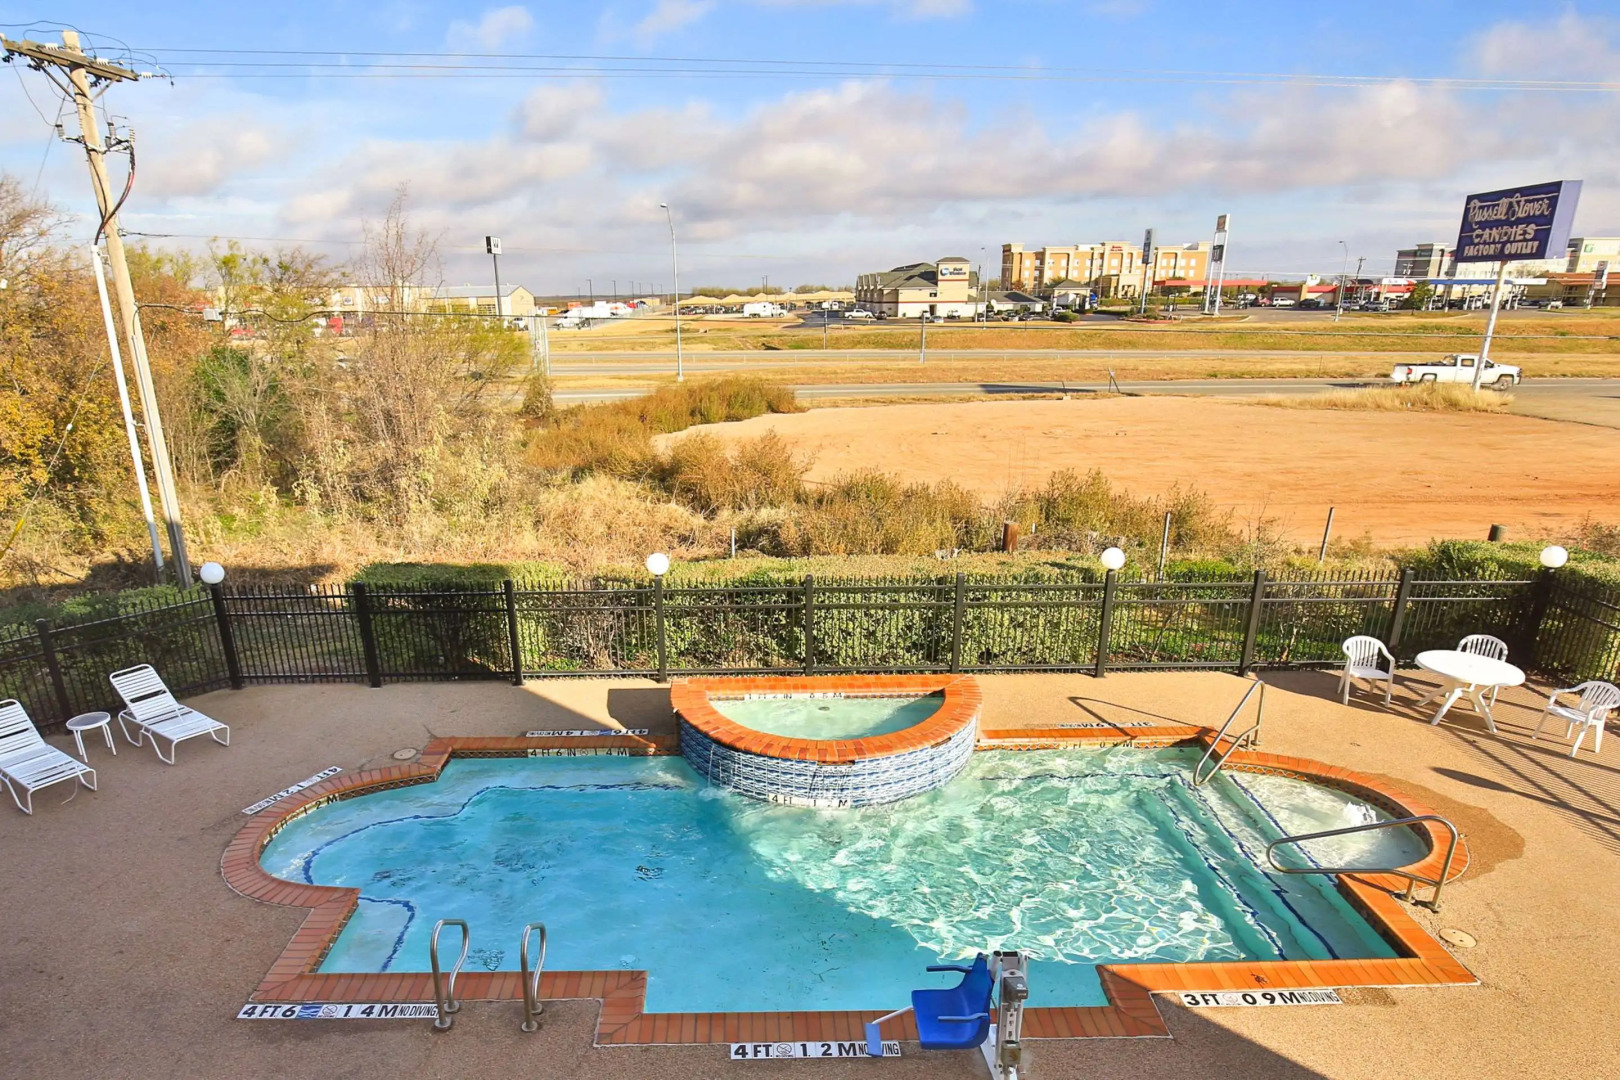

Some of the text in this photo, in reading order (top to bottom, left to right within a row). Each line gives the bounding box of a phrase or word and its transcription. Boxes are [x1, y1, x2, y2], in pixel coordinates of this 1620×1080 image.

[1469, 193, 1552, 228] Russell Stover
[1472, 224, 1537, 243] CANDIES
[1463, 241, 1540, 257] FACTORY OUTLET
[409, 1005, 438, 1016] DIVING
